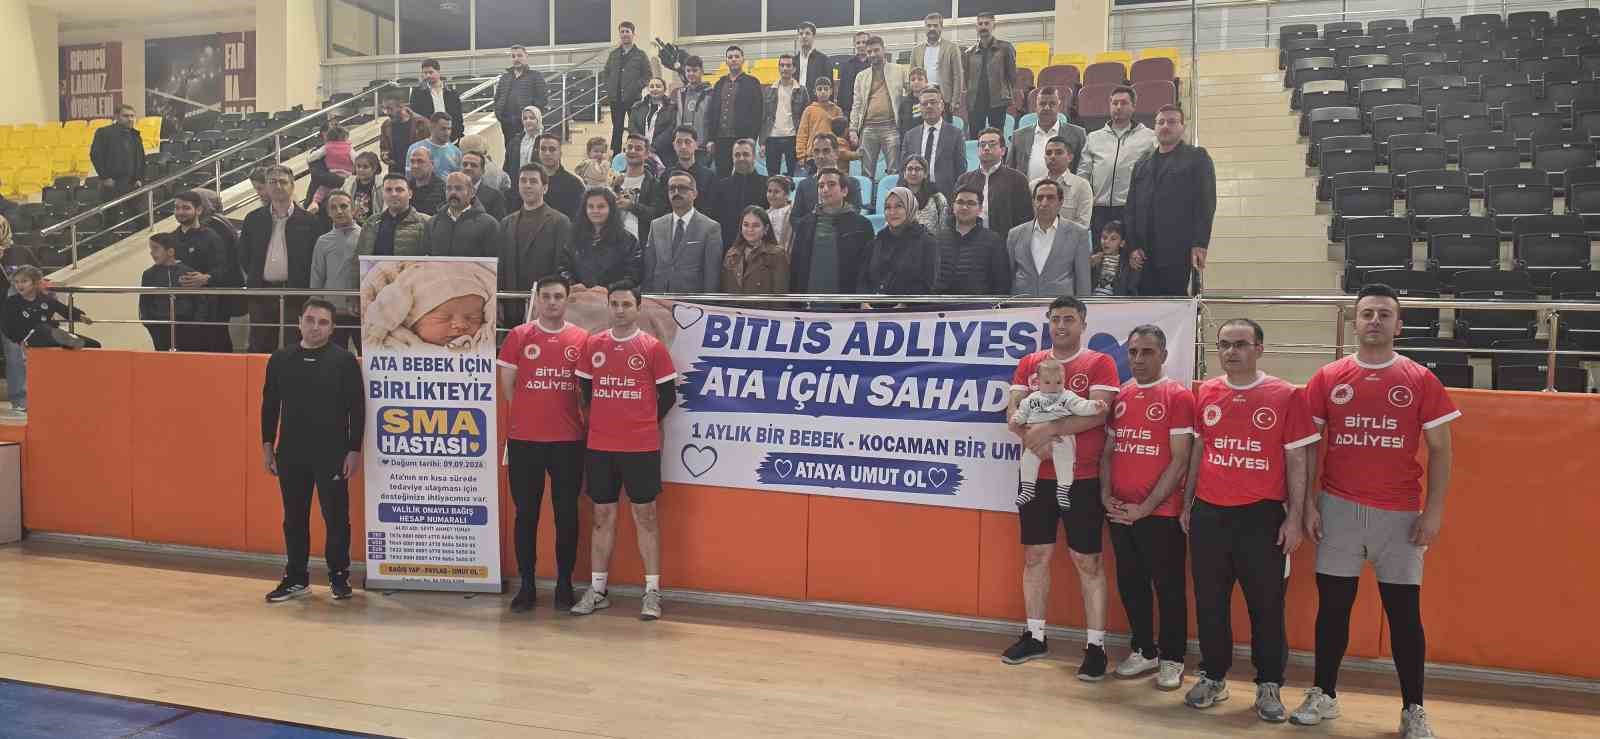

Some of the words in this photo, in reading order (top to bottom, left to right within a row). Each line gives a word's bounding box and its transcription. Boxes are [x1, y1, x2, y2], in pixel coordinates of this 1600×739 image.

[702, 311, 833, 354] BİTLİS
[370, 356, 398, 371] ATA
[402, 357, 454, 373] BEBEK
[460, 354, 492, 376] İÇİN
[369, 375, 493, 401] BİRLİKTEYİZ
[700, 366, 766, 400] ATA
[776, 364, 859, 411] İÇİN
[867, 374, 1009, 413] SAHAD
[383, 408, 481, 435] SMA
[1345, 413, 1398, 430] BİTLİS
[382, 435, 468, 455] HASTASI
[691, 423, 701, 438] 1
[705, 423, 752, 443] AYLIK
[756, 424, 785, 446] BİR
[789, 429, 845, 449] BEBEK
[859, 433, 949, 458] KOCAMAN
[955, 436, 986, 458] BİR
[992, 442, 1021, 461] UM
[1214, 436, 1262, 452] BİTLİS
[391, 459, 417, 469] Doğum
[795, 461, 846, 481] ATAYA
[851, 464, 899, 487] UMUT
[903, 469, 927, 488] OL
[399, 515, 425, 523] HESAP
[422, 505, 450, 514] ONAYLI
